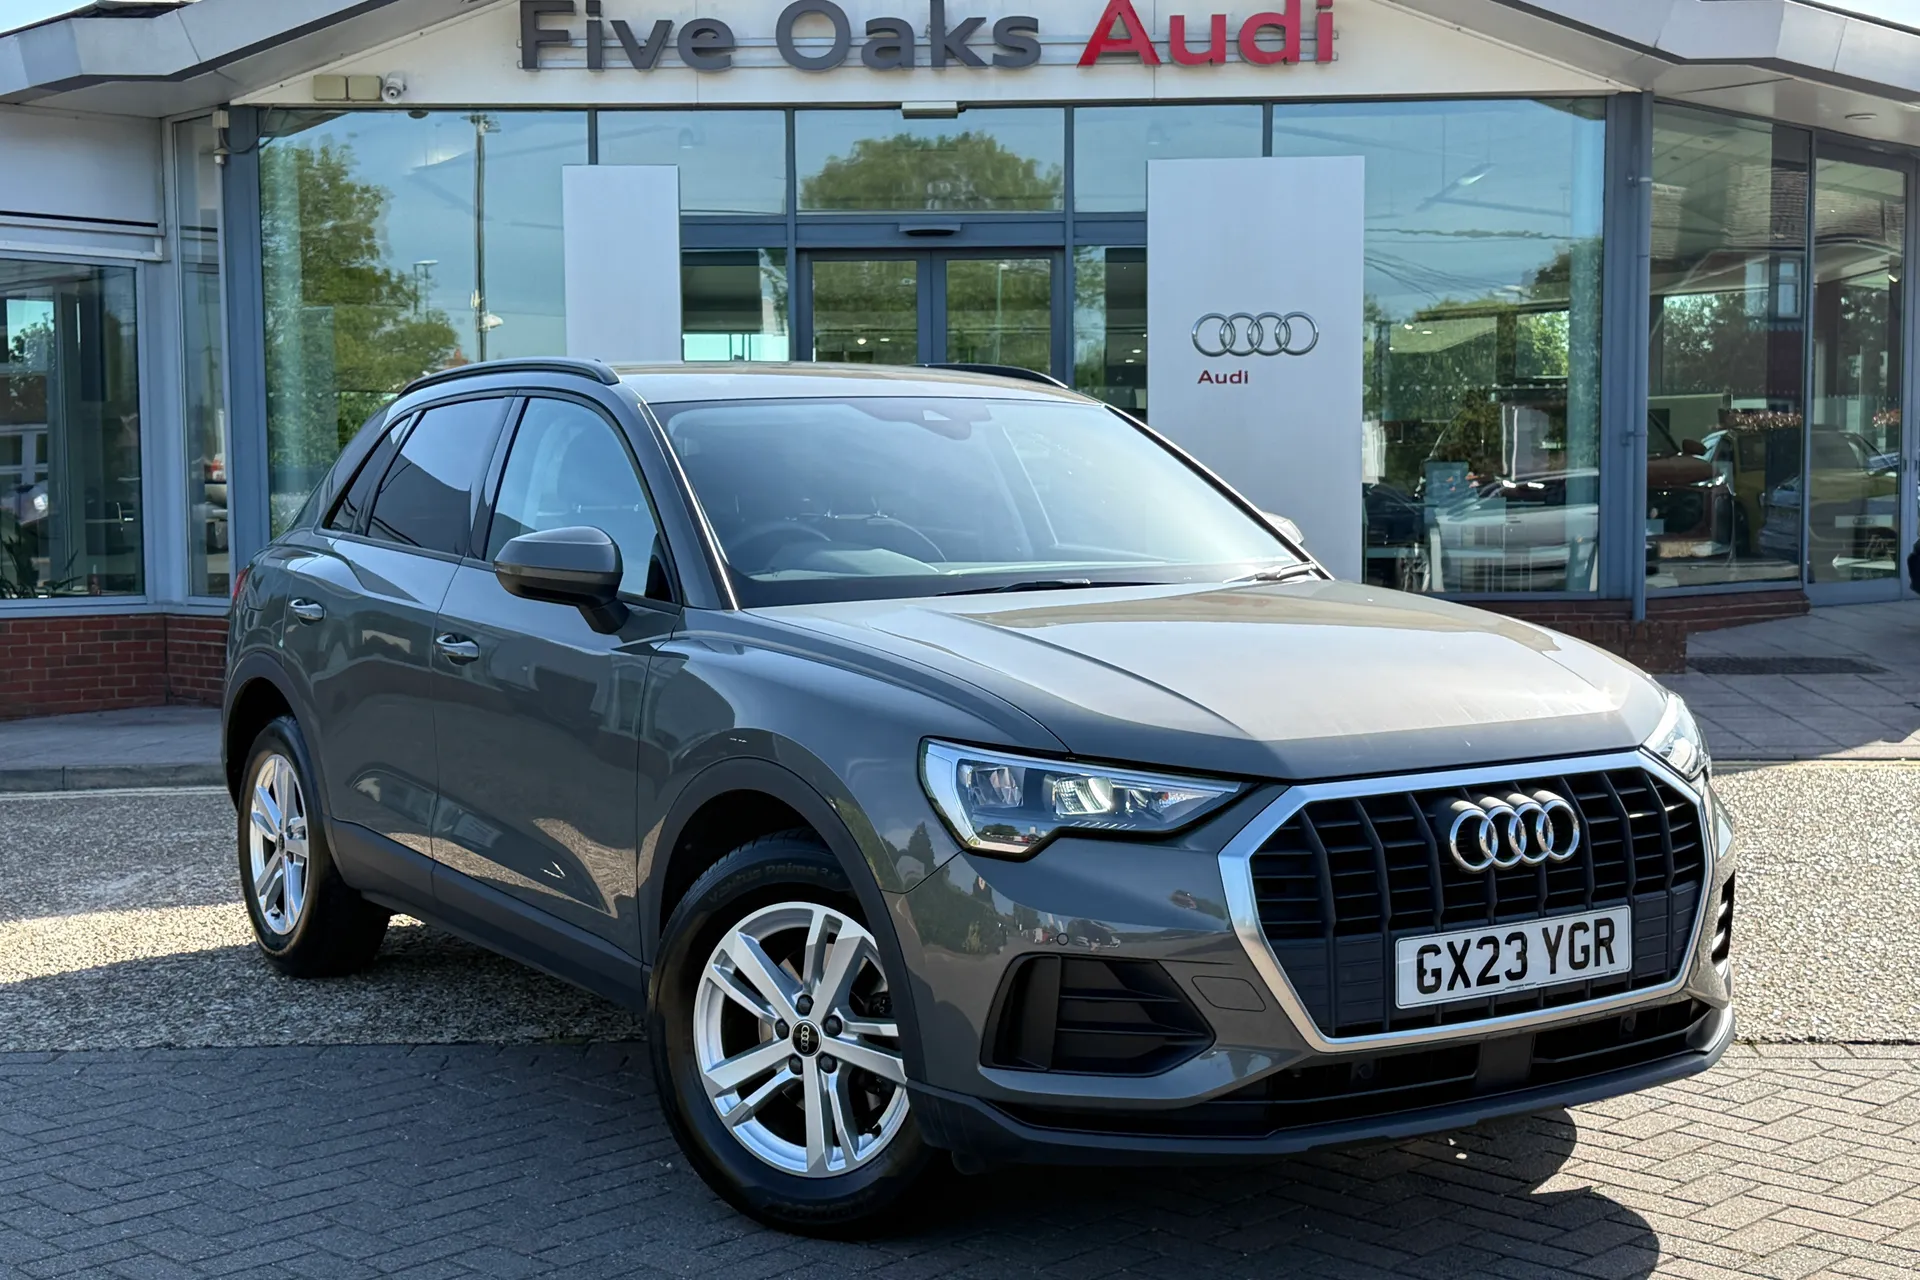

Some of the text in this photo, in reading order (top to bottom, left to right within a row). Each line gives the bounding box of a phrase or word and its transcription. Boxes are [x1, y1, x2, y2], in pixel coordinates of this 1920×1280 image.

[520, 0, 1333, 72] Five Oaks Audi
[1197, 369, 1249, 385] Audi
[1416, 917, 1616, 995] GX23 YGR
